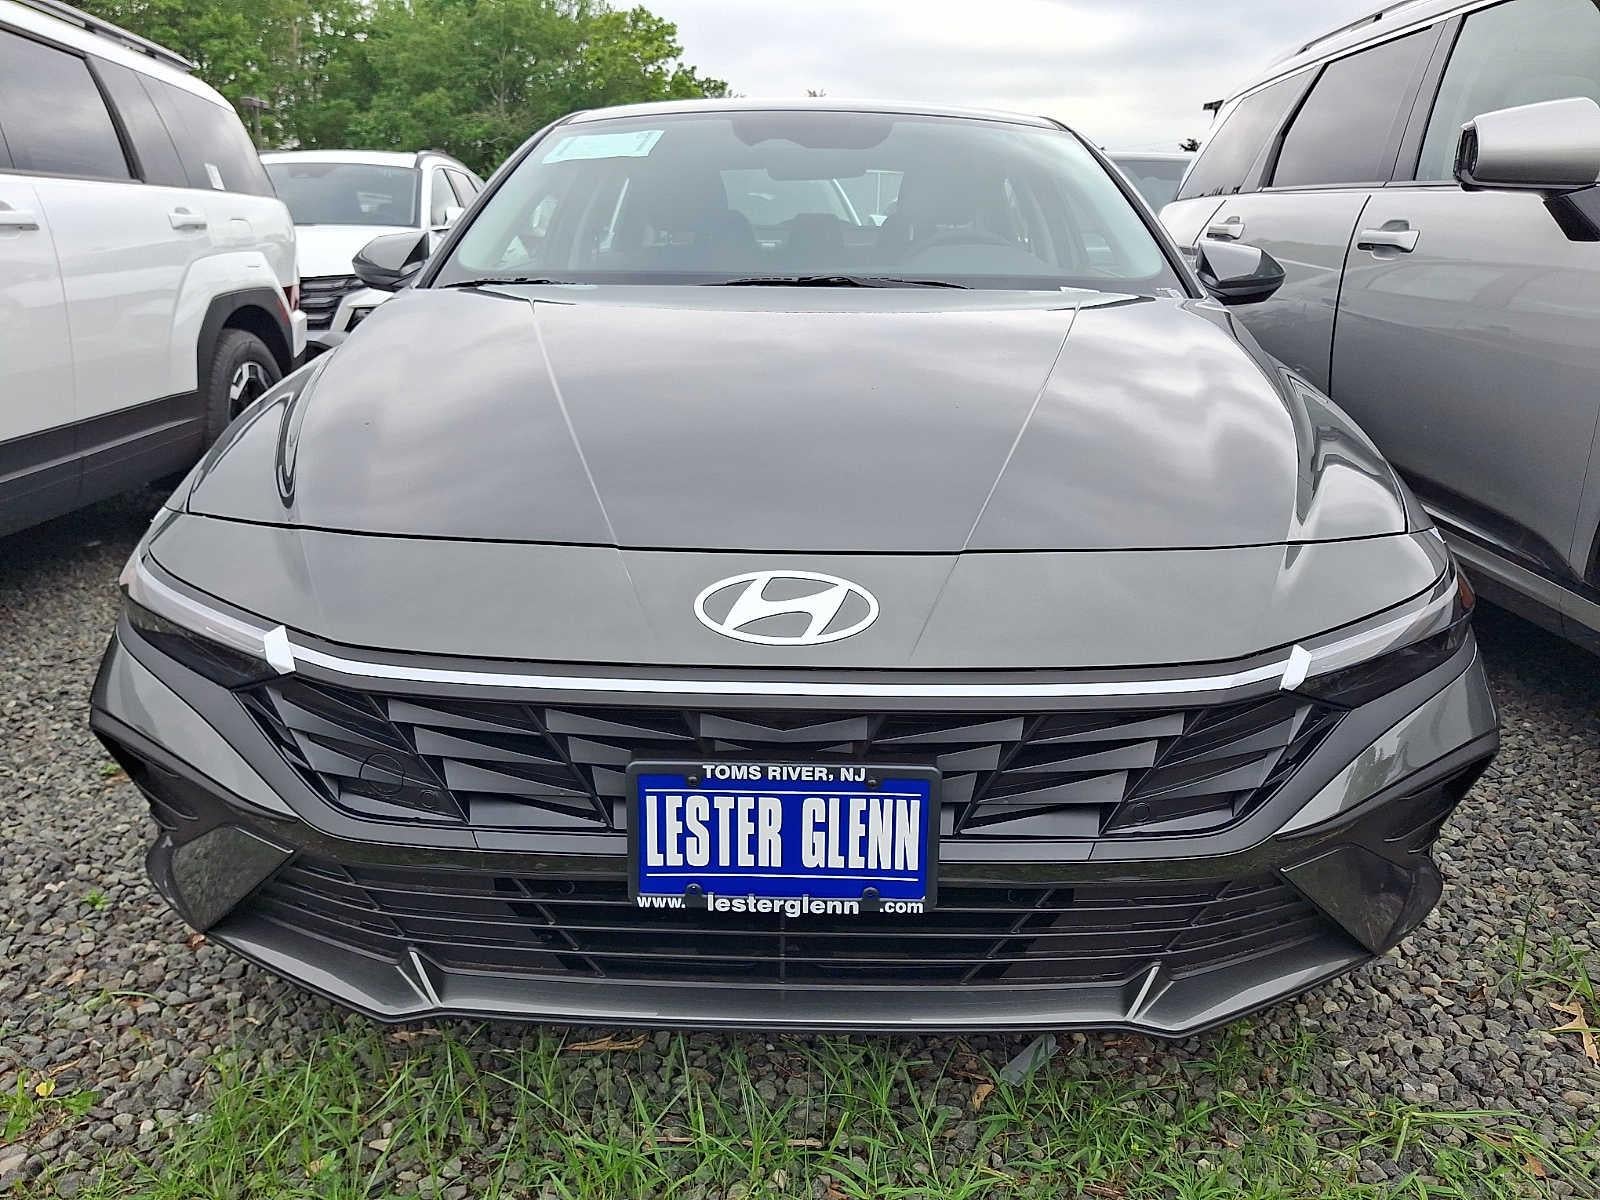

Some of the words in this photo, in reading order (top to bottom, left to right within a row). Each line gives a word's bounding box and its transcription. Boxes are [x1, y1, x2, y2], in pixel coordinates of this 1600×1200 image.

[702, 764, 762, 780] TOMS
[767, 766, 834, 781] RIVER,
[840, 767, 866, 782] NJ
[645, 795, 782, 867] LESTER
[801, 797, 920, 870] GLENN
[636, 896, 686, 908] www.
[707, 894, 859, 917] lesterglenn
[879, 901, 924, 913] .com
